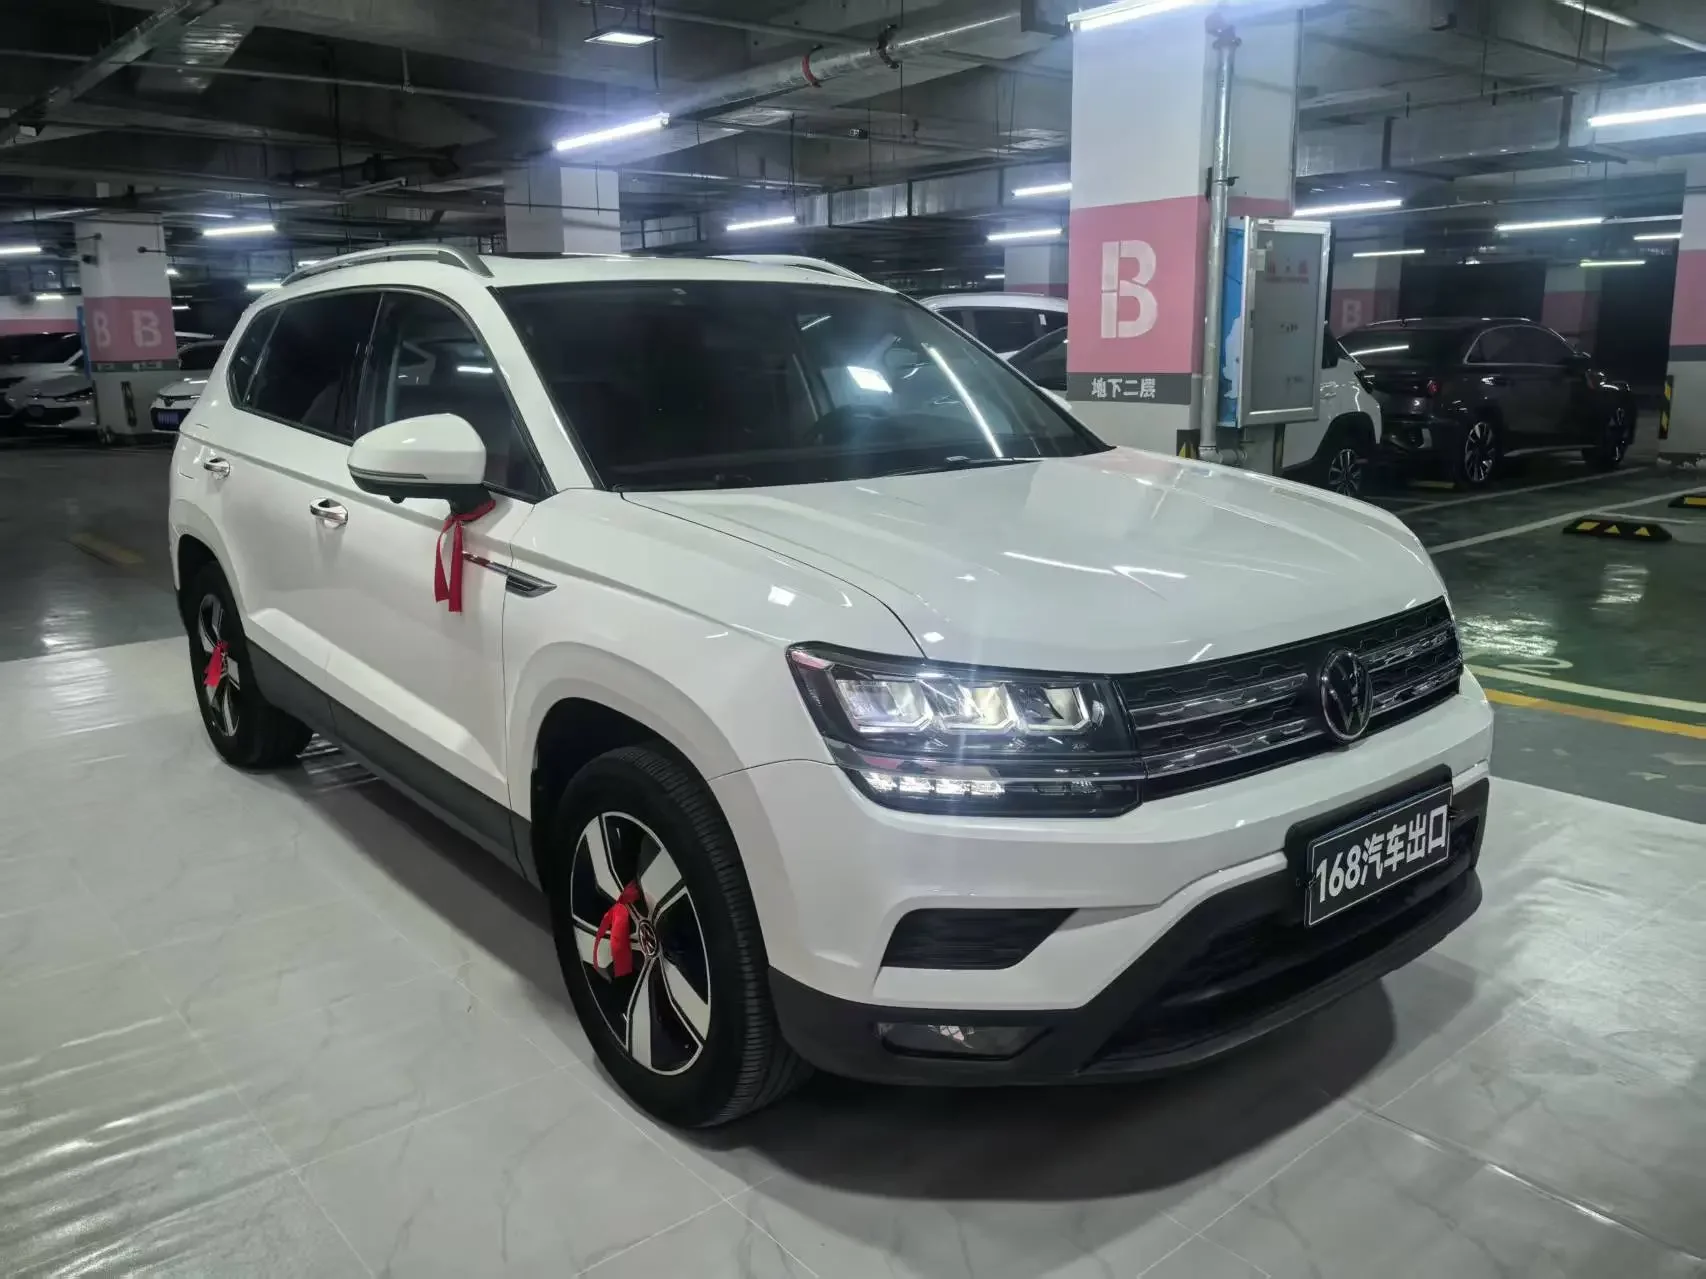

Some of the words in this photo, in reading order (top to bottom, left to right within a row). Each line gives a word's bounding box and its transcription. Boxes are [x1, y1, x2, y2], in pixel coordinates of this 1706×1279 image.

[1101, 240, 1158, 338] B
[131, 310, 162, 347] B
[1342, 299, 1362, 329] B
[1091, 377, 1157, 398] 地下二层
[1316, 804, 1448, 903] 168汽车出口
